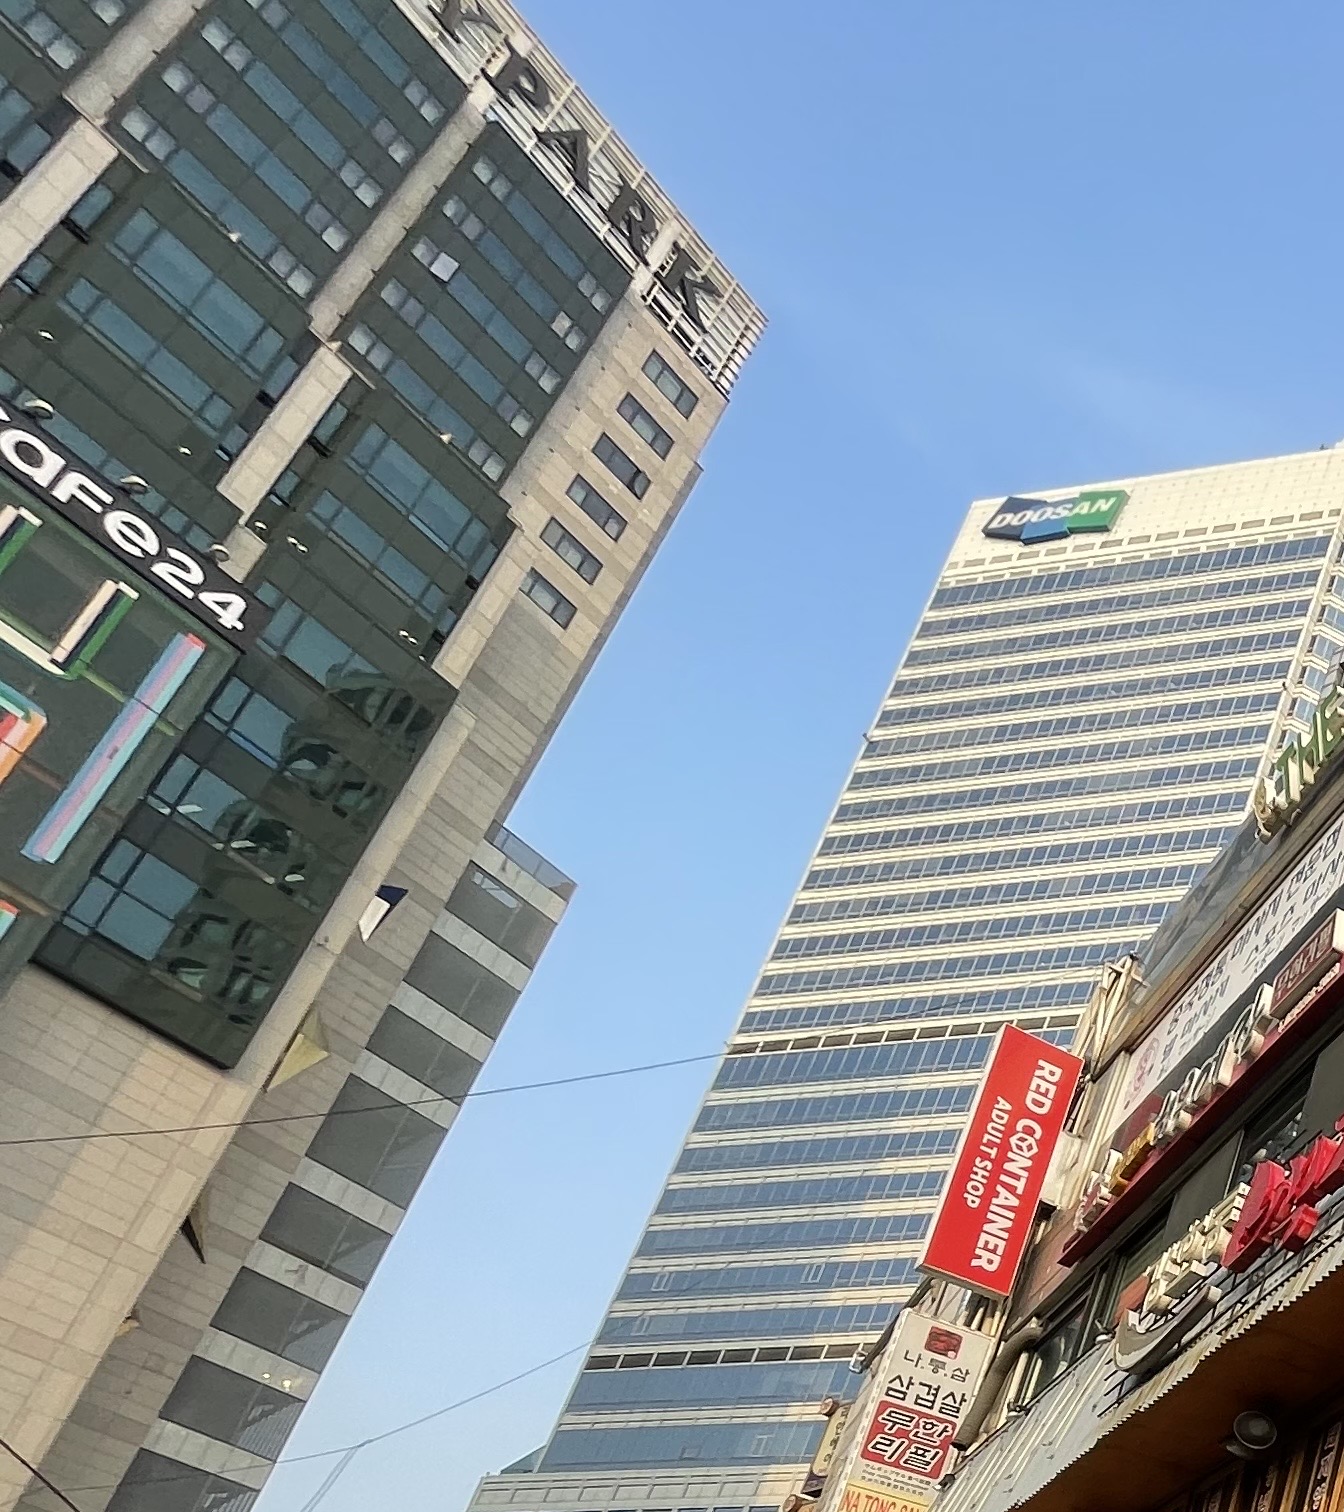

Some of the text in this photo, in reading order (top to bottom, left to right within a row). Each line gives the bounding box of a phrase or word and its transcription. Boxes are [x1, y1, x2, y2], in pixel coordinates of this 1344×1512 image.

[987, 497, 1117, 529] DOOSAN
[1024, 1058, 1063, 1115] RED
[963, 1095, 1013, 1209] ADULT SHOP
[969, 1118, 1043, 1273] CONTAINER
[885, 1374, 968, 1419] 삼겹살
[877, 1407, 953, 1446] 무한
[867, 1431, 944, 1473] 리필
